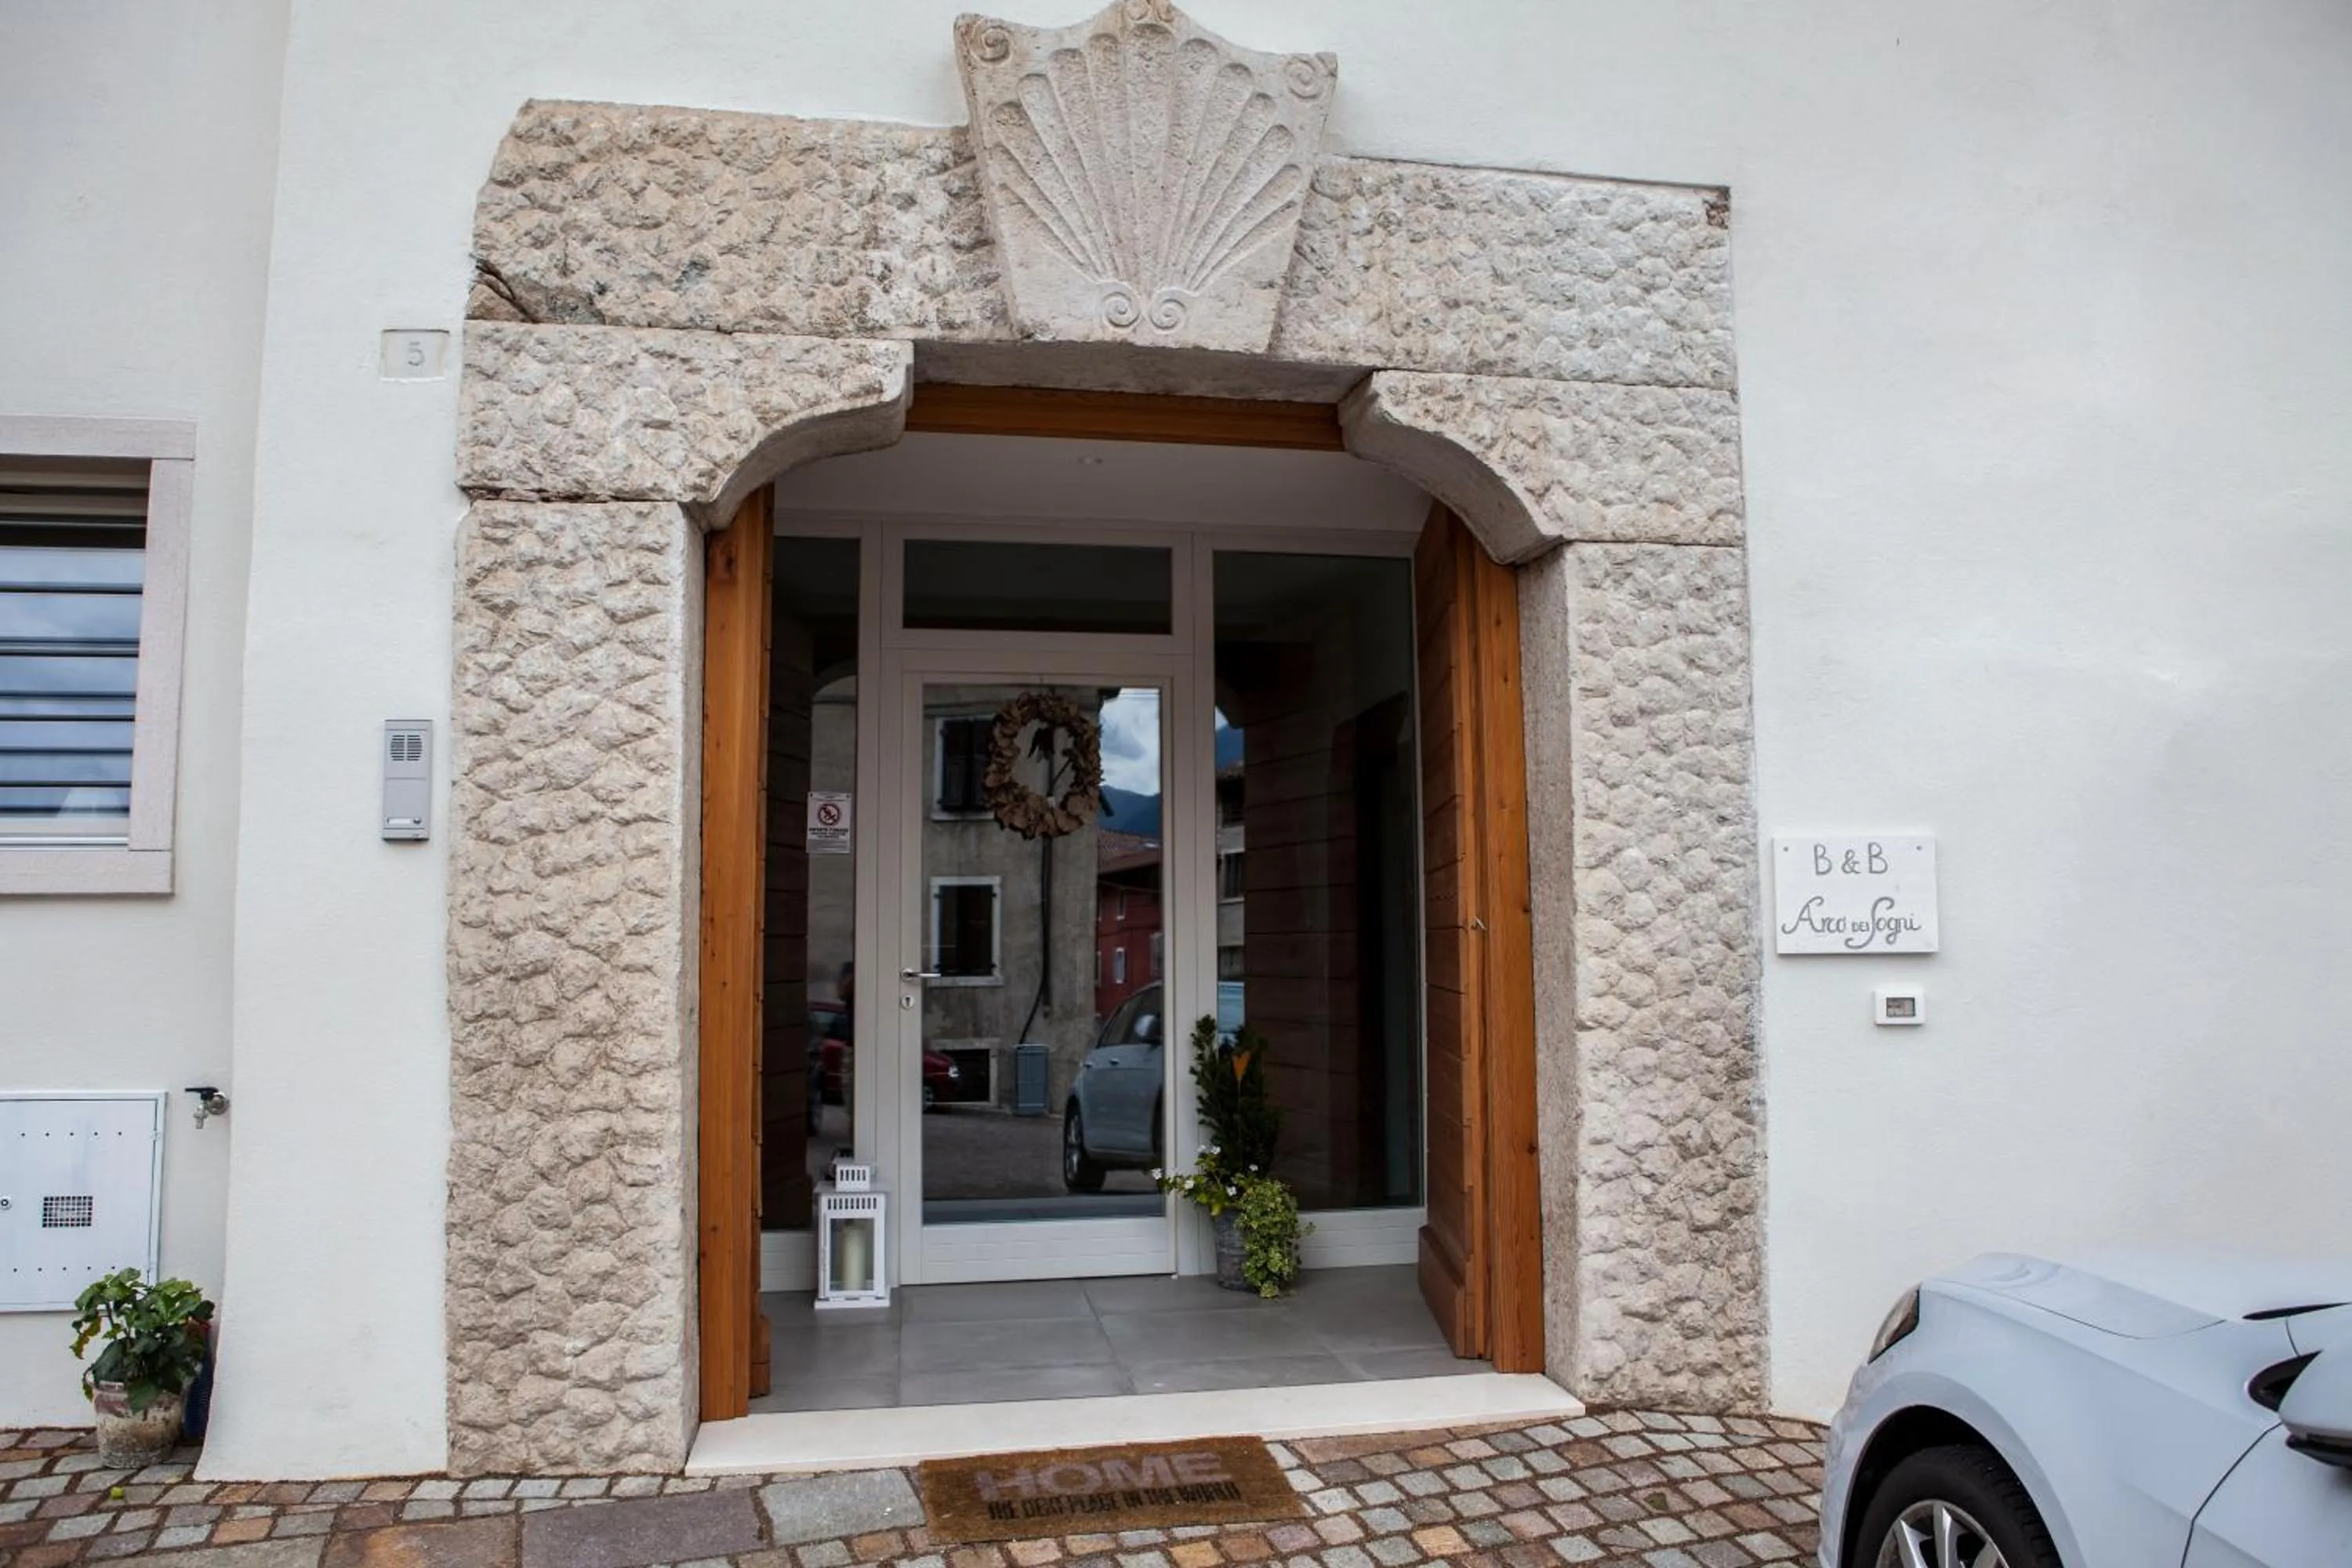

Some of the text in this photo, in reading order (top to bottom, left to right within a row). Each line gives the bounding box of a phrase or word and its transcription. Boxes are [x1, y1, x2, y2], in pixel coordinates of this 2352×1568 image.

[408, 341, 425, 366] 5
[1813, 842, 1889, 876] B & B
[1781, 896, 1846, 935] Arco
[1844, 896, 1922, 949] Sogni
[975, 1452, 1233, 1502] HOME
